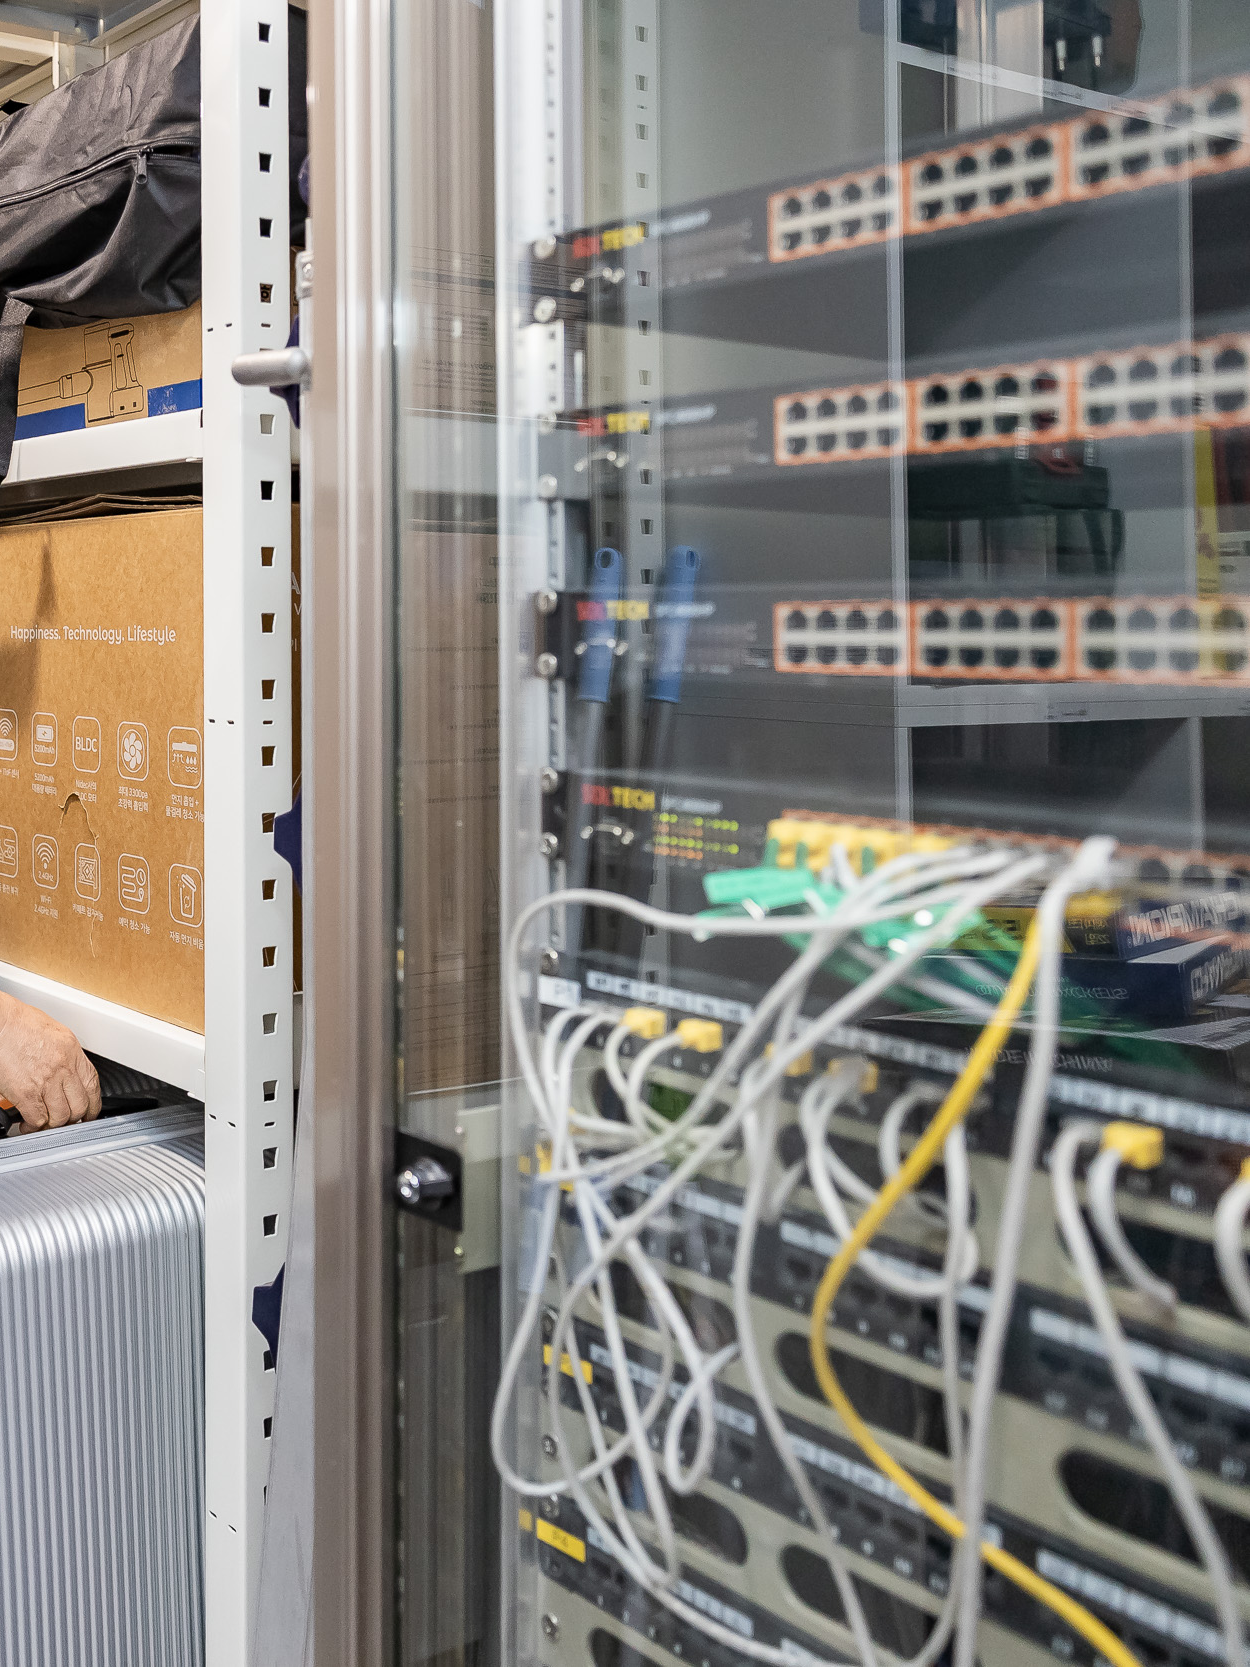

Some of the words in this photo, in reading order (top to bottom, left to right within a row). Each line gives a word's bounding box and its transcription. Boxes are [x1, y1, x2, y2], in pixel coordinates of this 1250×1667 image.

[10, 625, 61, 642] Happiness.
[63, 625, 125, 645] Technology.
[127, 625, 177, 646] Lifestyle
[75, 736, 98, 752] BLDC
